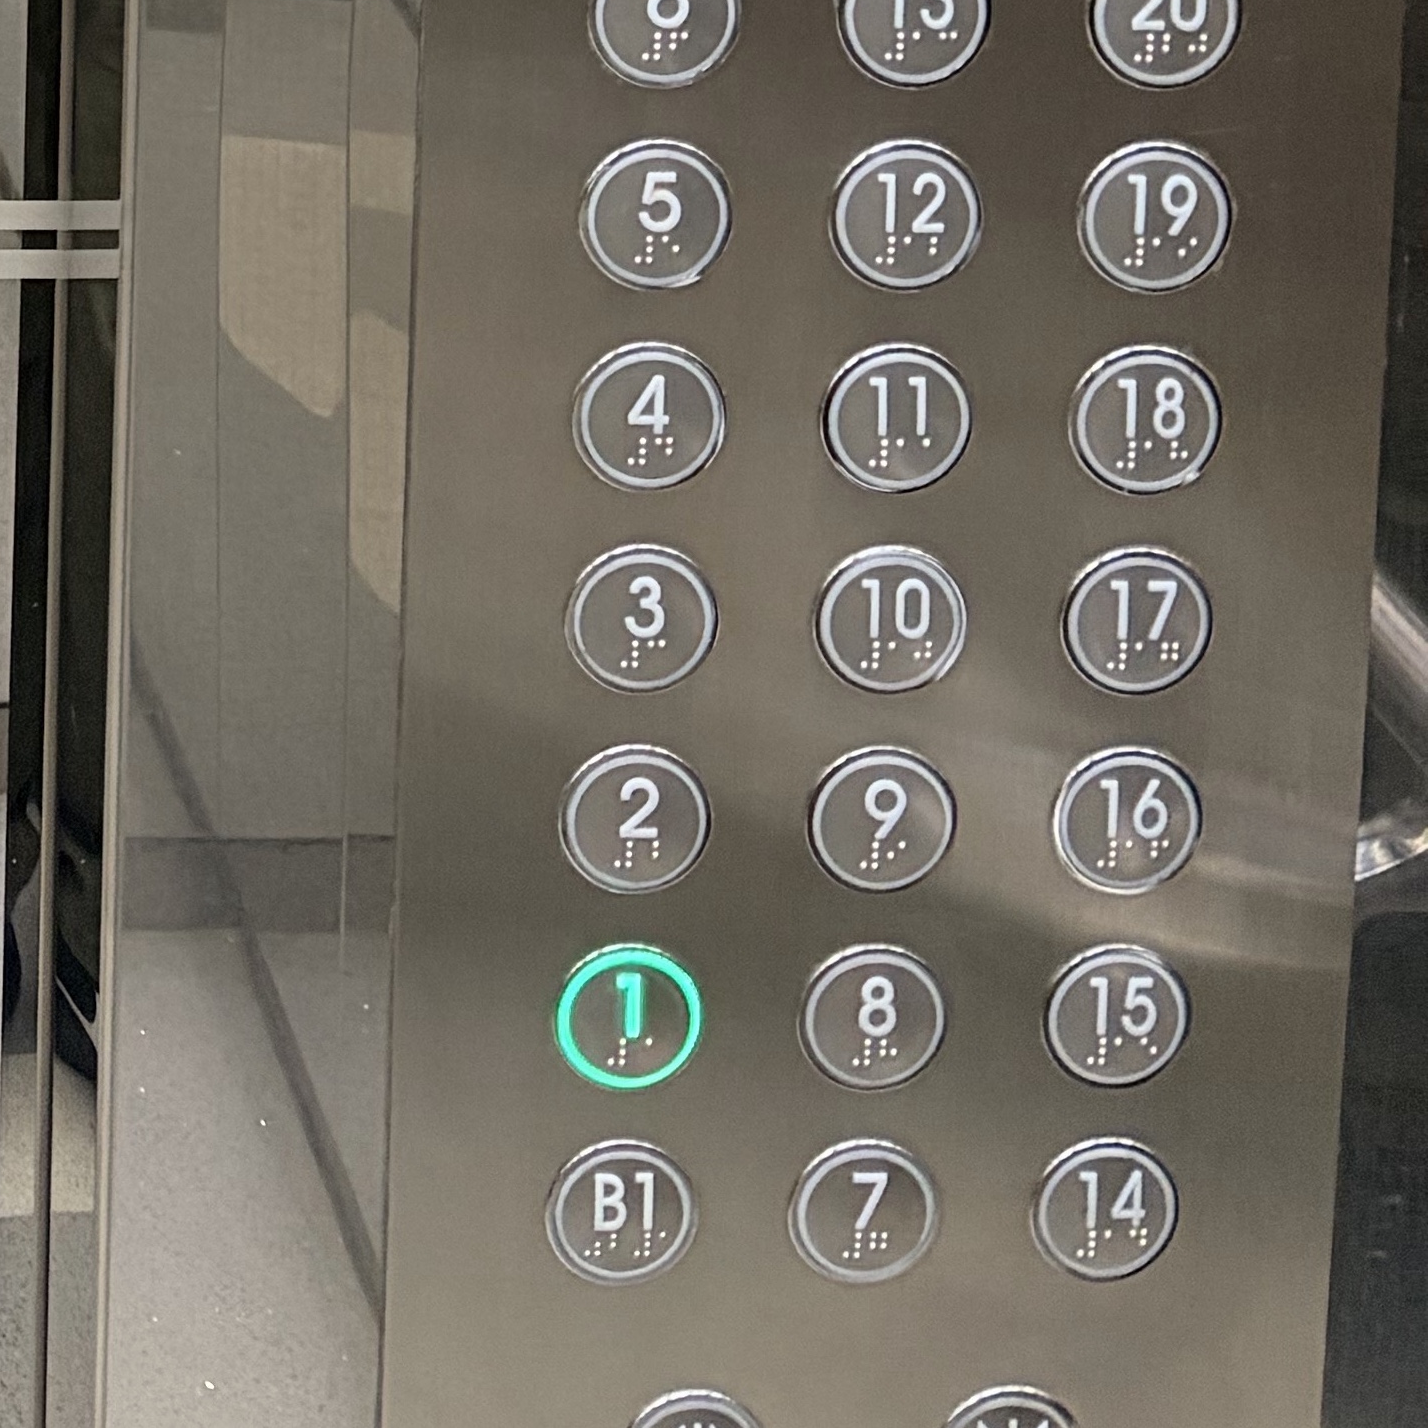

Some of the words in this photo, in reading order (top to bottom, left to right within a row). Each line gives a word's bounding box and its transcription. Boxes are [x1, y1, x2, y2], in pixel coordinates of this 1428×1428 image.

[639, 171, 682, 234] 5
[877, 173, 945, 234] 12
[1126, 174, 1199, 237] 19
[627, 374, 670, 434] 4
[868, 375, 929, 436] 11
[1116, 377, 1186, 440] 18
[625, 575, 666, 638] 3
[861, 578, 932, 639] 10
[1109, 579, 1179, 641] 17
[618, 778, 660, 839] 2
[864, 779, 908, 841] 9
[1099, 779, 1168, 841] 16
[616, 973, 642, 1038] 1
[857, 975, 897, 1037] 8
[1089, 977, 1157, 1037] 15
[594, 1172, 656, 1232] B1
[852, 1172, 890, 1229] 7
[1077, 1171, 1146, 1228] 14
